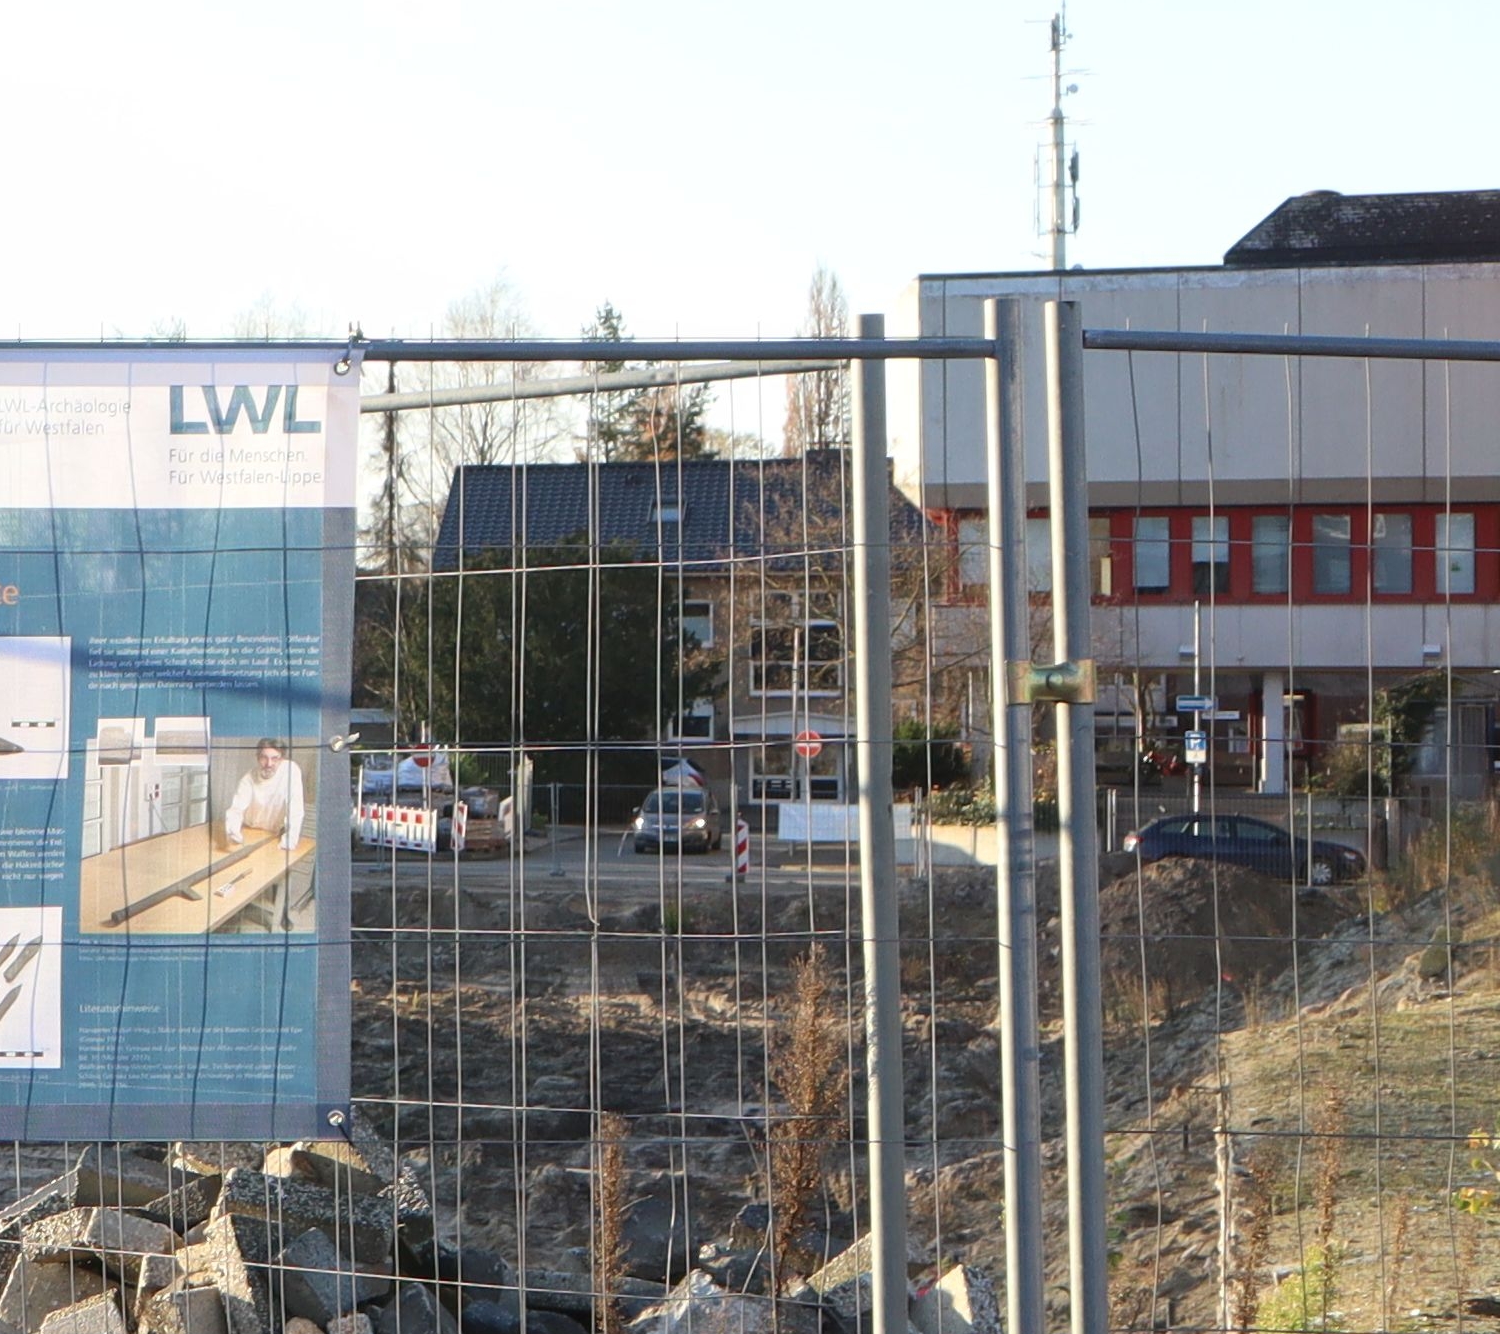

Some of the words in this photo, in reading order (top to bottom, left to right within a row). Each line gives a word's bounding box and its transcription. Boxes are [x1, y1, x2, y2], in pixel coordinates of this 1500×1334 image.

[169, 385, 321, 434] LWL
[25, 419, 105, 435] Westfalen
[169, 449, 194, 463] Für
[199, 448, 223, 463] die
[229, 448, 308, 463] Menschen.
[169, 471, 194, 484] Für
